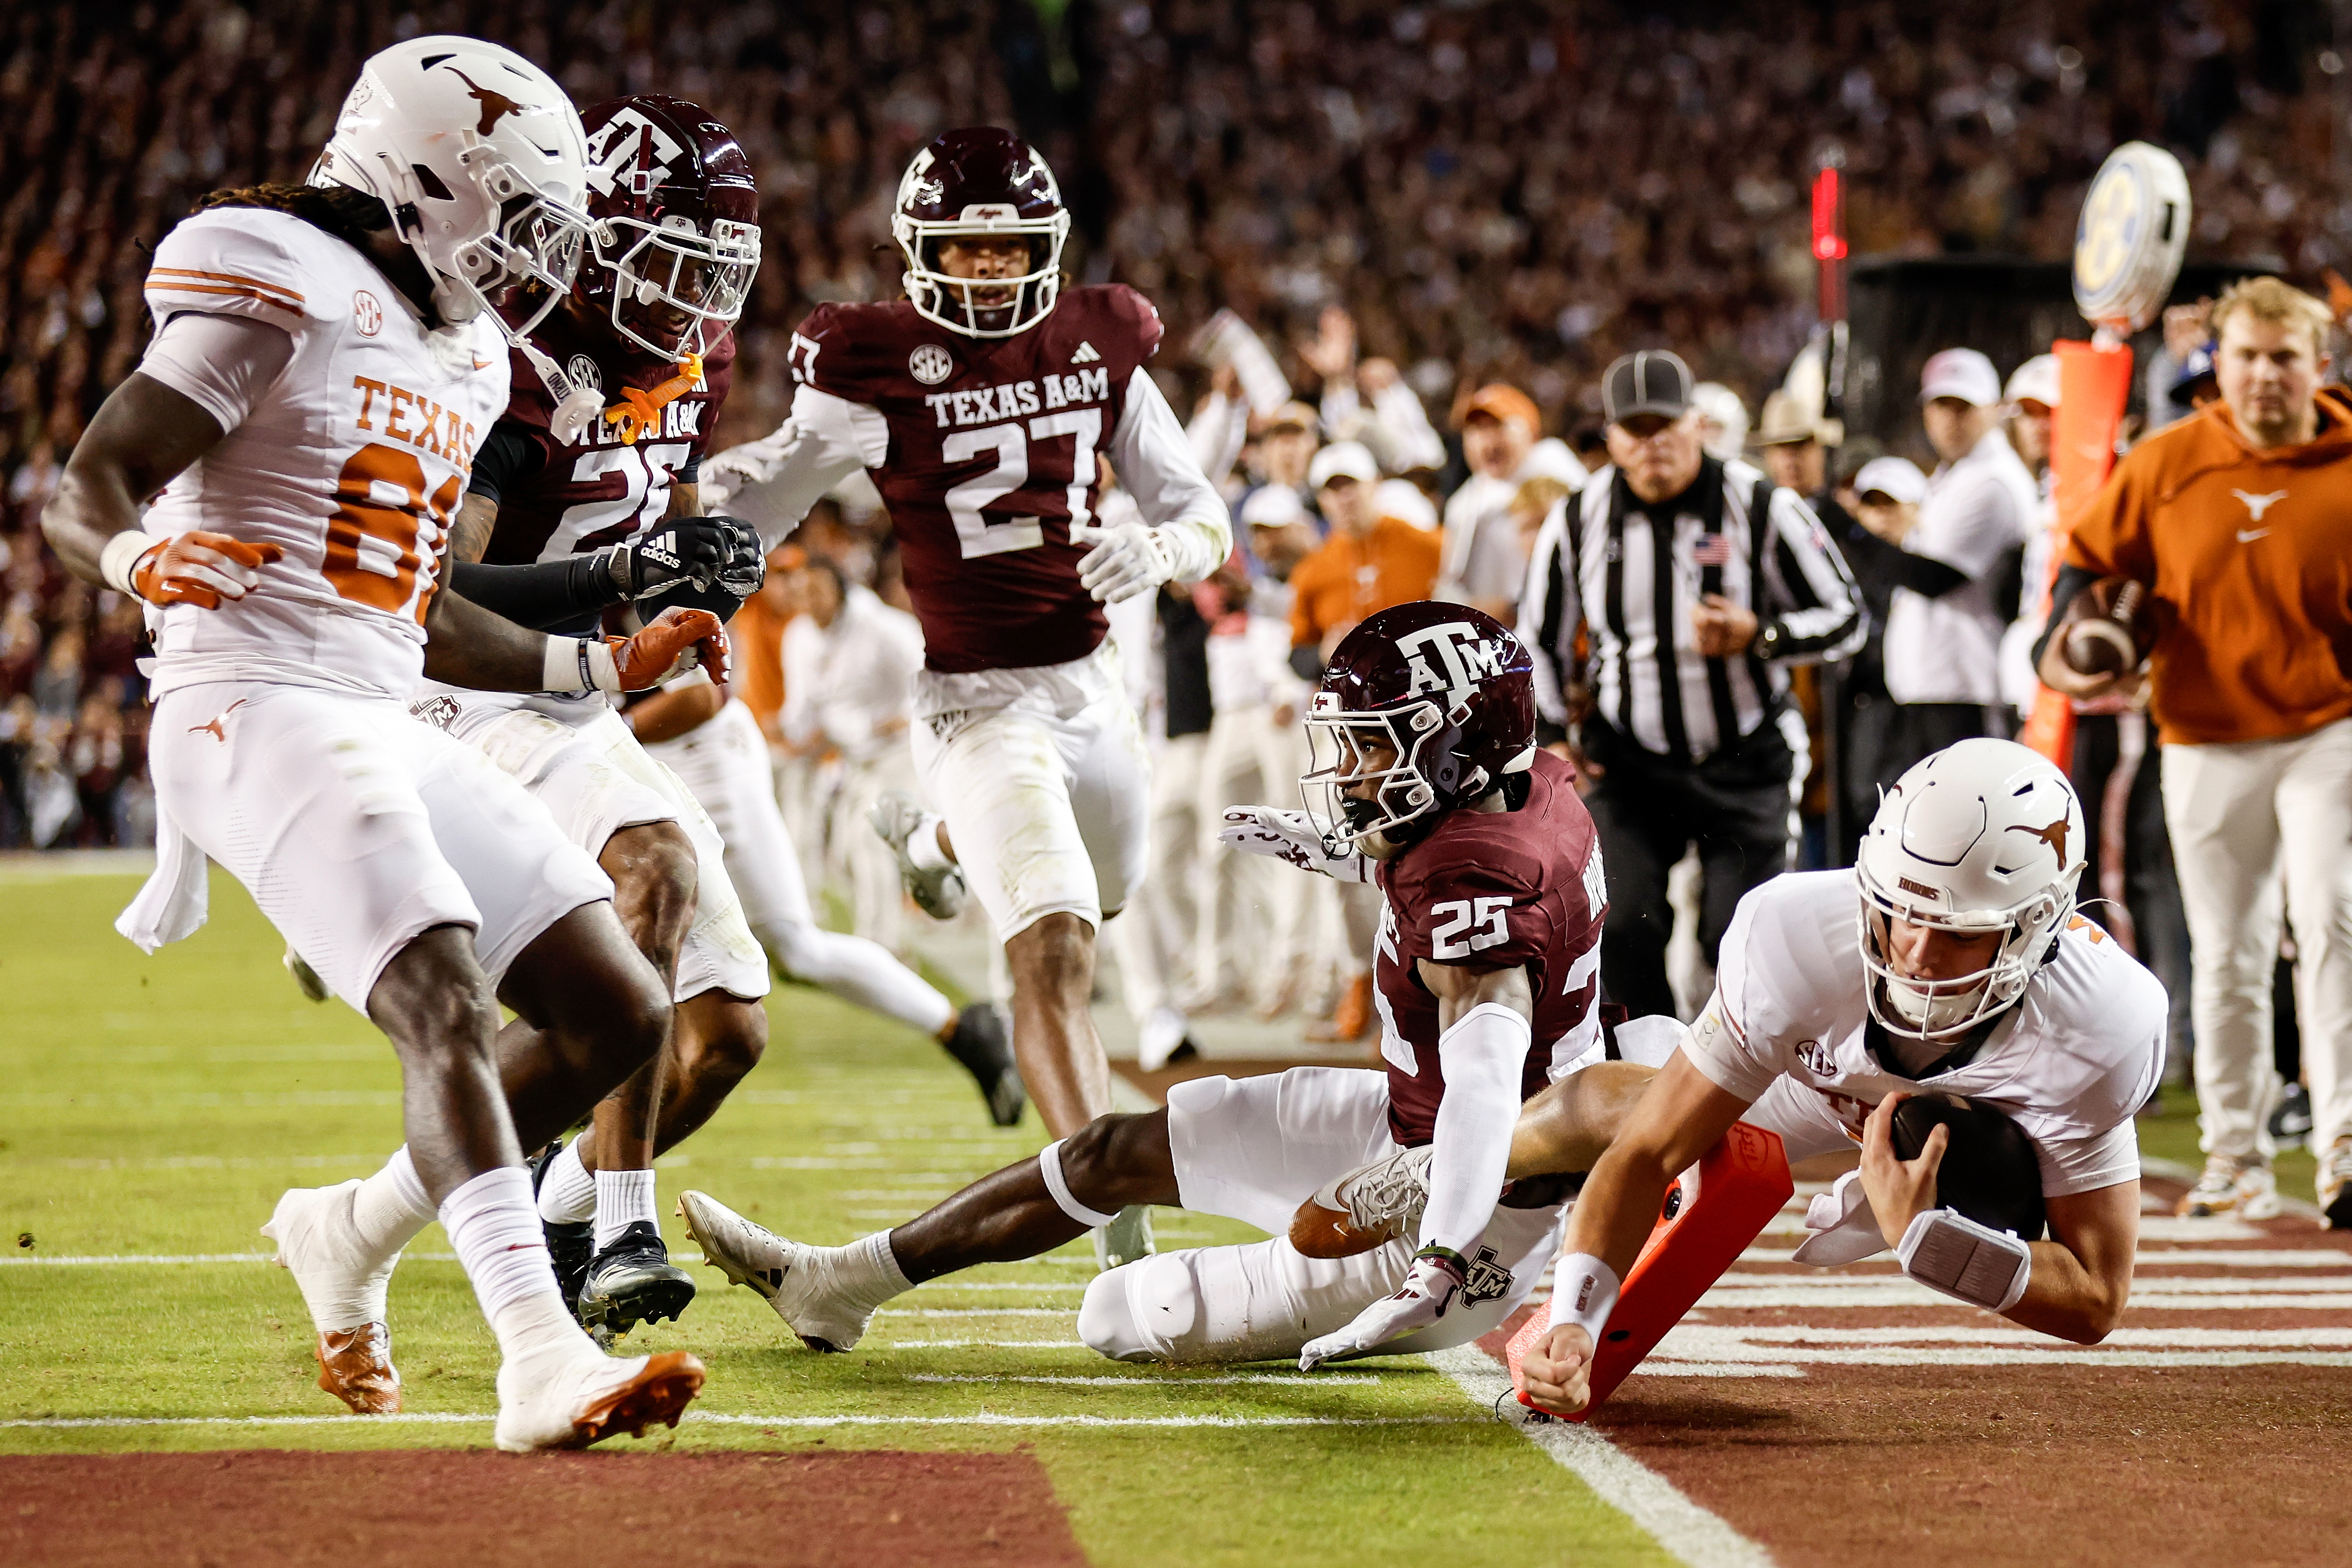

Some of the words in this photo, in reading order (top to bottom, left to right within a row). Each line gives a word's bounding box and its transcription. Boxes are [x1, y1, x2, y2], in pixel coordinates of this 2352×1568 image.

[355, 290, 382, 338] SEC
[569, 355, 601, 391] SEC
[911, 346, 951, 381] SEC
[925, 380, 1039, 428] TEXAS
[1043, 366, 1108, 410] A&M
[354, 375, 475, 473] TEXAS
[942, 407, 1102, 560] 27
[640, 546, 681, 569] adidas
[1430, 897, 1513, 960] 25
[1796, 1041, 1838, 1076] SEC
